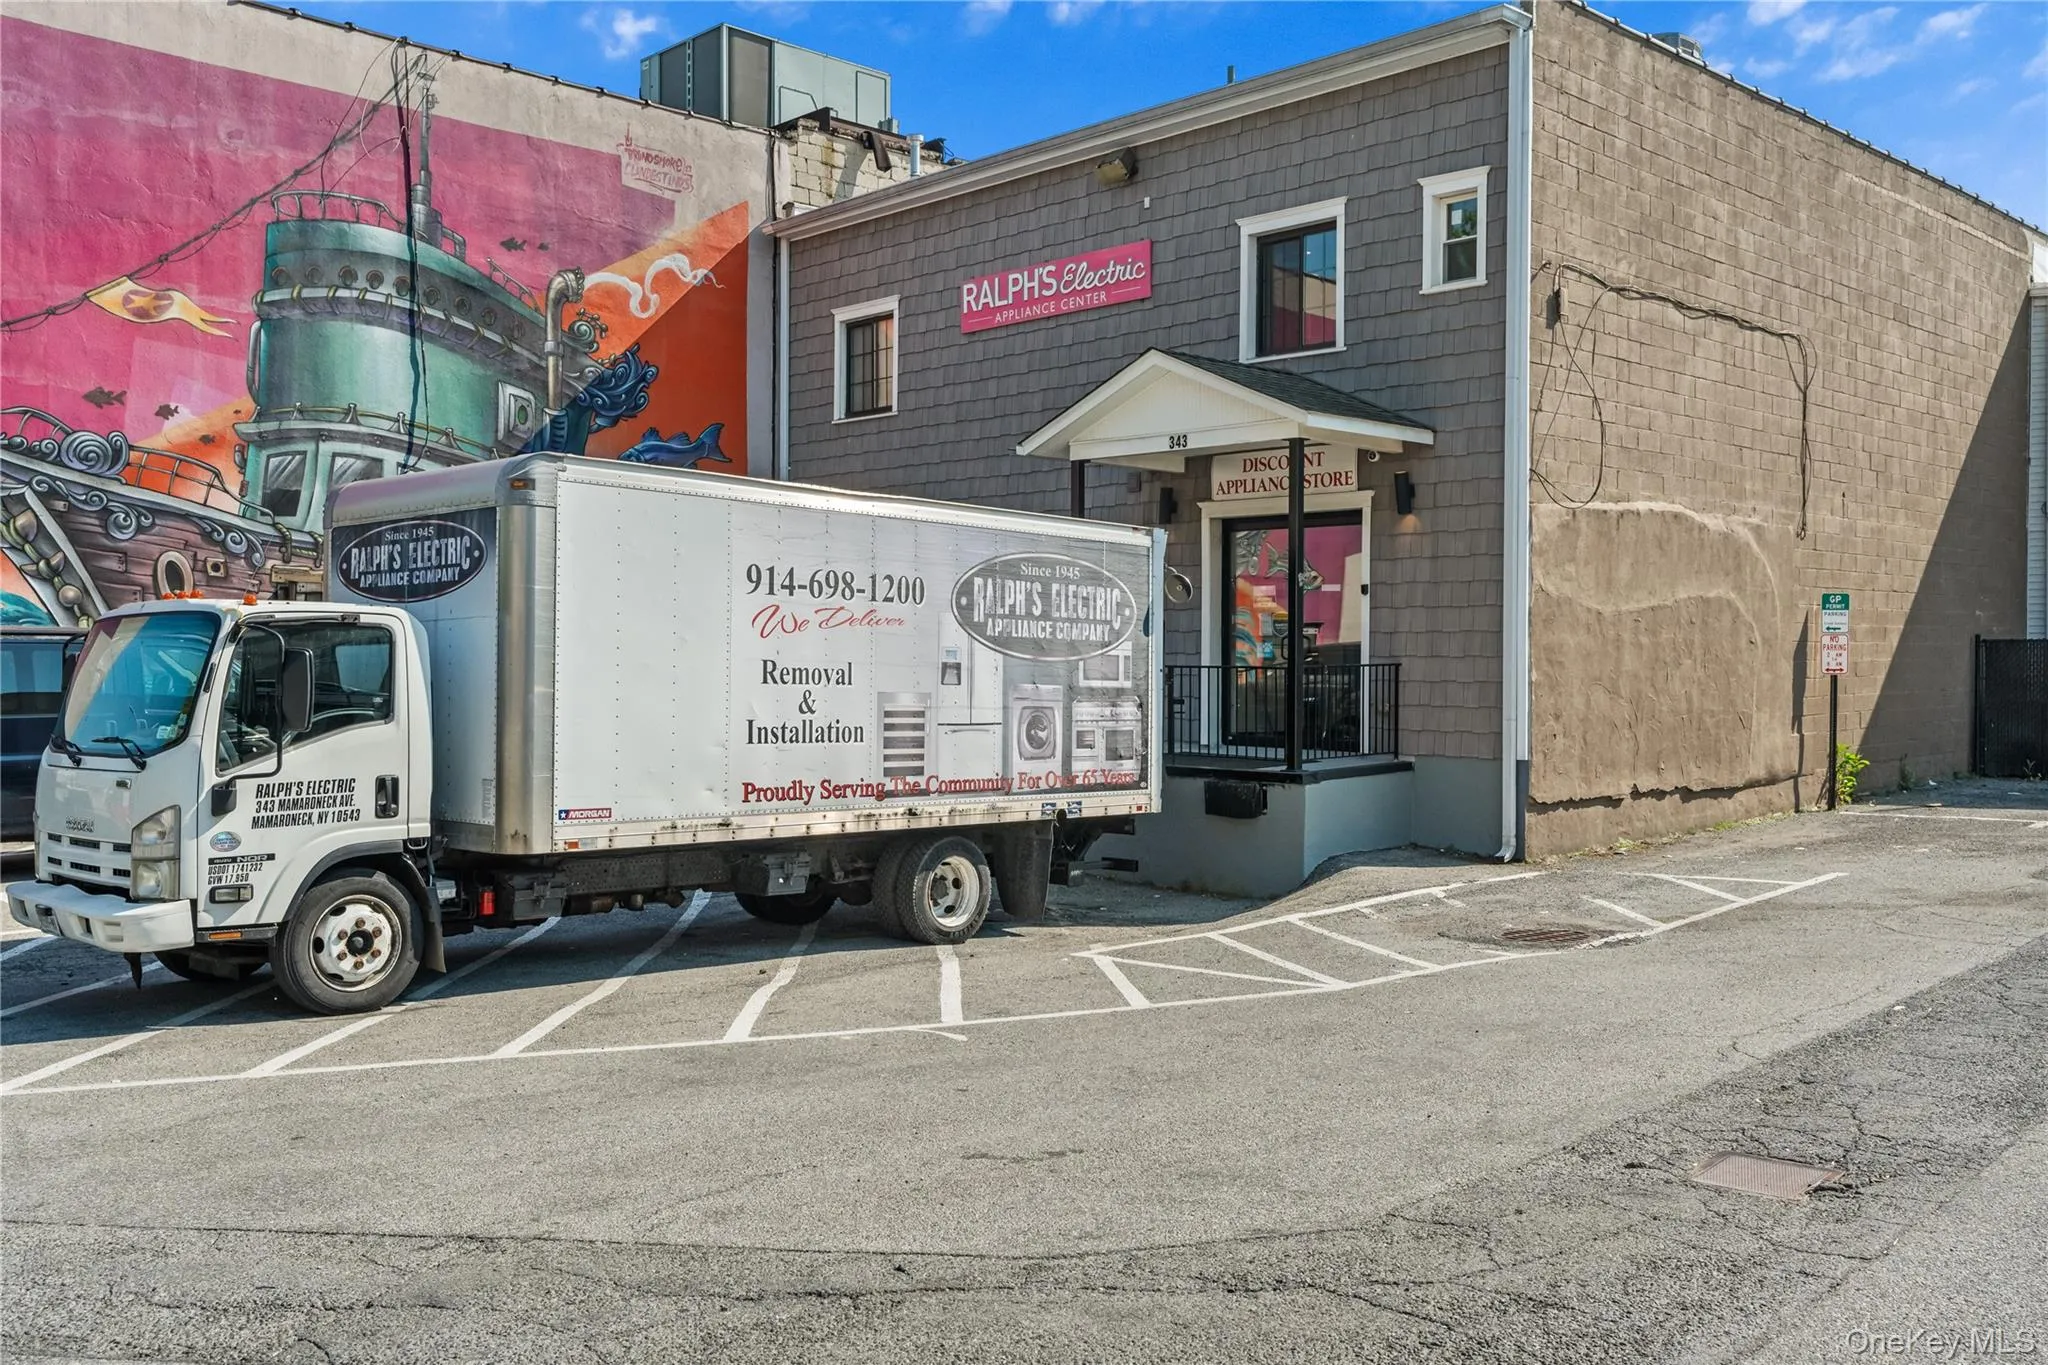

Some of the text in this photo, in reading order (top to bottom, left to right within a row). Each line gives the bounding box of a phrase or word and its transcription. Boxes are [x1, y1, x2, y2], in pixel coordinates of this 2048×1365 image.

[963, 258, 1146, 313] RALPH'S Electric
[995, 291, 1107, 323] APPLIANCE CENTER
[1169, 434, 1188, 449] 343
[1242, 451, 1325, 473] DISCONT
[1216, 470, 1354, 496] APPLIANC STORE
[384, 526, 435, 541] Since 1945
[350, 535, 471, 580] RALPH'S ELECTRIC
[360, 567, 461, 588] APPLIANCE COMPANY
[1020, 563, 1081, 580] Since 1945
[746, 563, 926, 605] 914-698-1200
[973, 577, 1121, 630] RALPH'S ELECTRIC
[1830, 595, 1842, 603] GP
[752, 604, 906, 639] We Deliver
[986, 618, 1111, 642] APPLIANCE COMPANY
[1830, 635, 1840, 643] NO
[761, 659, 853, 686] Removal
[798, 689, 817, 715] &
[746, 719, 864, 744] Installation
[255, 778, 356, 799] RALPH'S ELECTRIC
[741, 768, 1137, 805] Proudly Serving The Community For Over 65 Years
[255, 794, 356, 814] 343 MAMARONECK AVE.
[568, 810, 610, 818] MORGAN
[251, 809, 361, 830] MAMARONECK, NY 10543
[208, 862, 264, 875] USDOT 1741232
[208, 875, 224, 885] GVW
